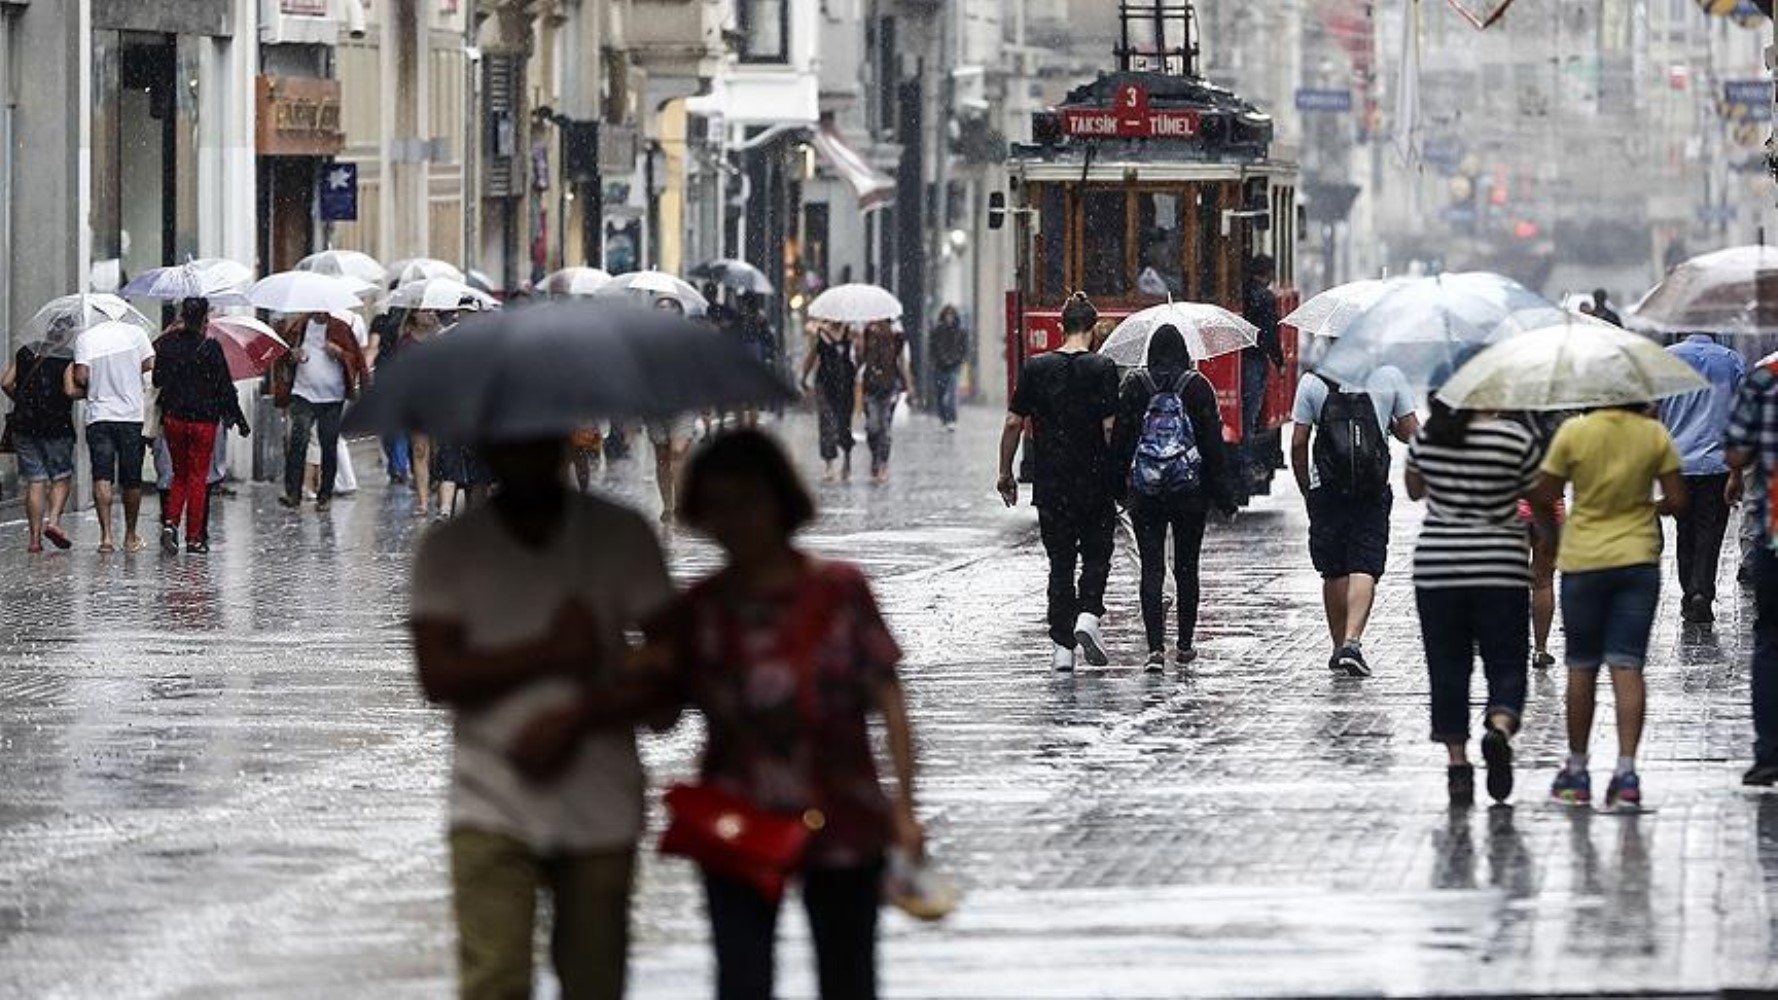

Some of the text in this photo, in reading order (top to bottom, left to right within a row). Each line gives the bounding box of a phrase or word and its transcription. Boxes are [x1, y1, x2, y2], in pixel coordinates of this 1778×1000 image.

[1126, 87, 1137, 108] 3
[1069, 114, 1118, 134] TAKSİM
[1149, 114, 1194, 135] TÜNEL
